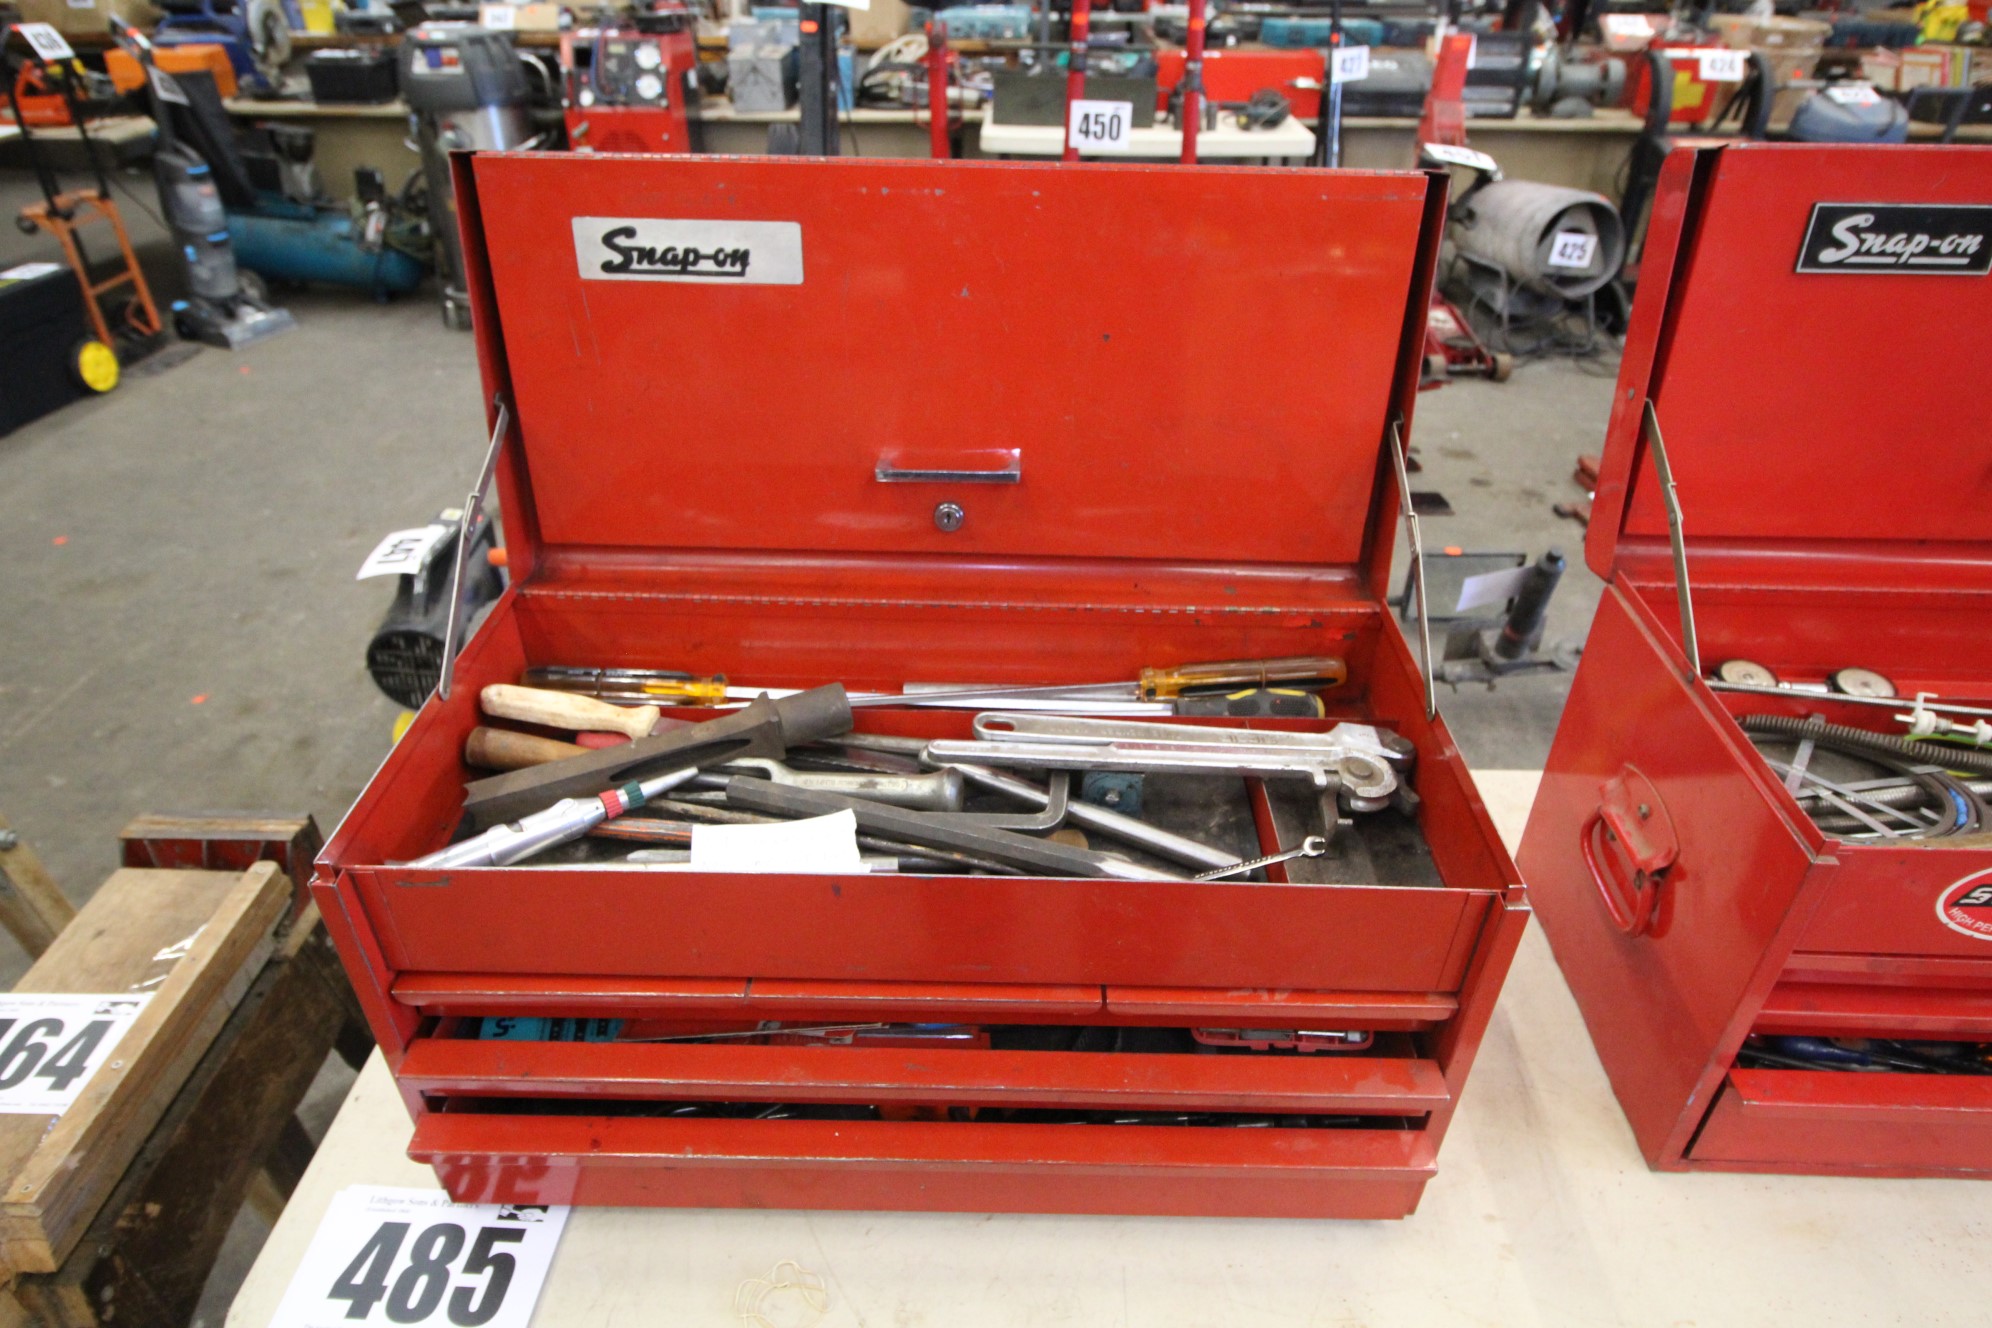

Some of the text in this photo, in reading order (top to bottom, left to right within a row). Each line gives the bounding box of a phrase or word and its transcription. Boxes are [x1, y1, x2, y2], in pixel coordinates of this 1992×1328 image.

[1078, 112, 1122, 141] 450
[600, 226, 750, 276] Snap-on
[1818, 213, 1984, 265] Snap-on
[1948, 907, 1976, 926] HIGH
[326, 1221, 527, 1327] 485
